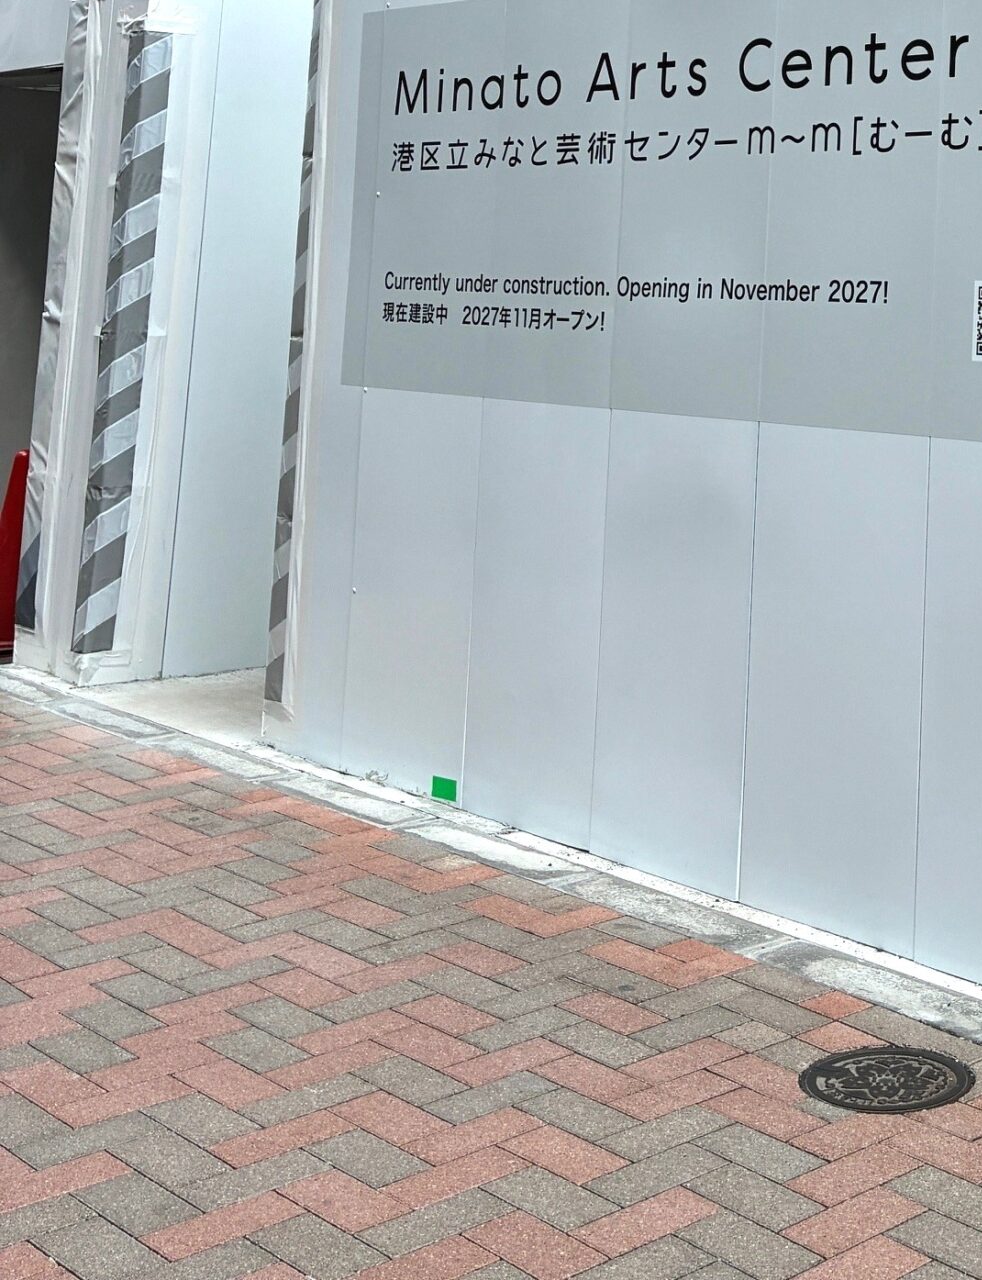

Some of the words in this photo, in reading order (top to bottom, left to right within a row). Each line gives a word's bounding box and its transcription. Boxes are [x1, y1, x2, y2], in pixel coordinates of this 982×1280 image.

[394, 64, 562, 116] Minato
[586, 51, 708, 103] Arts
[738, 32, 970, 93] Center
[384, 271, 451, 296] Currently
[455, 273, 499, 295] under
[502, 276, 610, 298] construction.
[616, 276, 690, 304] Opening
[696, 277, 713, 300] in
[720, 277, 821, 303] November
[827, 279, 889, 304] 2027!
[382, 301, 448, 326] 現在建設中
[461, 305, 606, 332] 2027年11月オープン!
